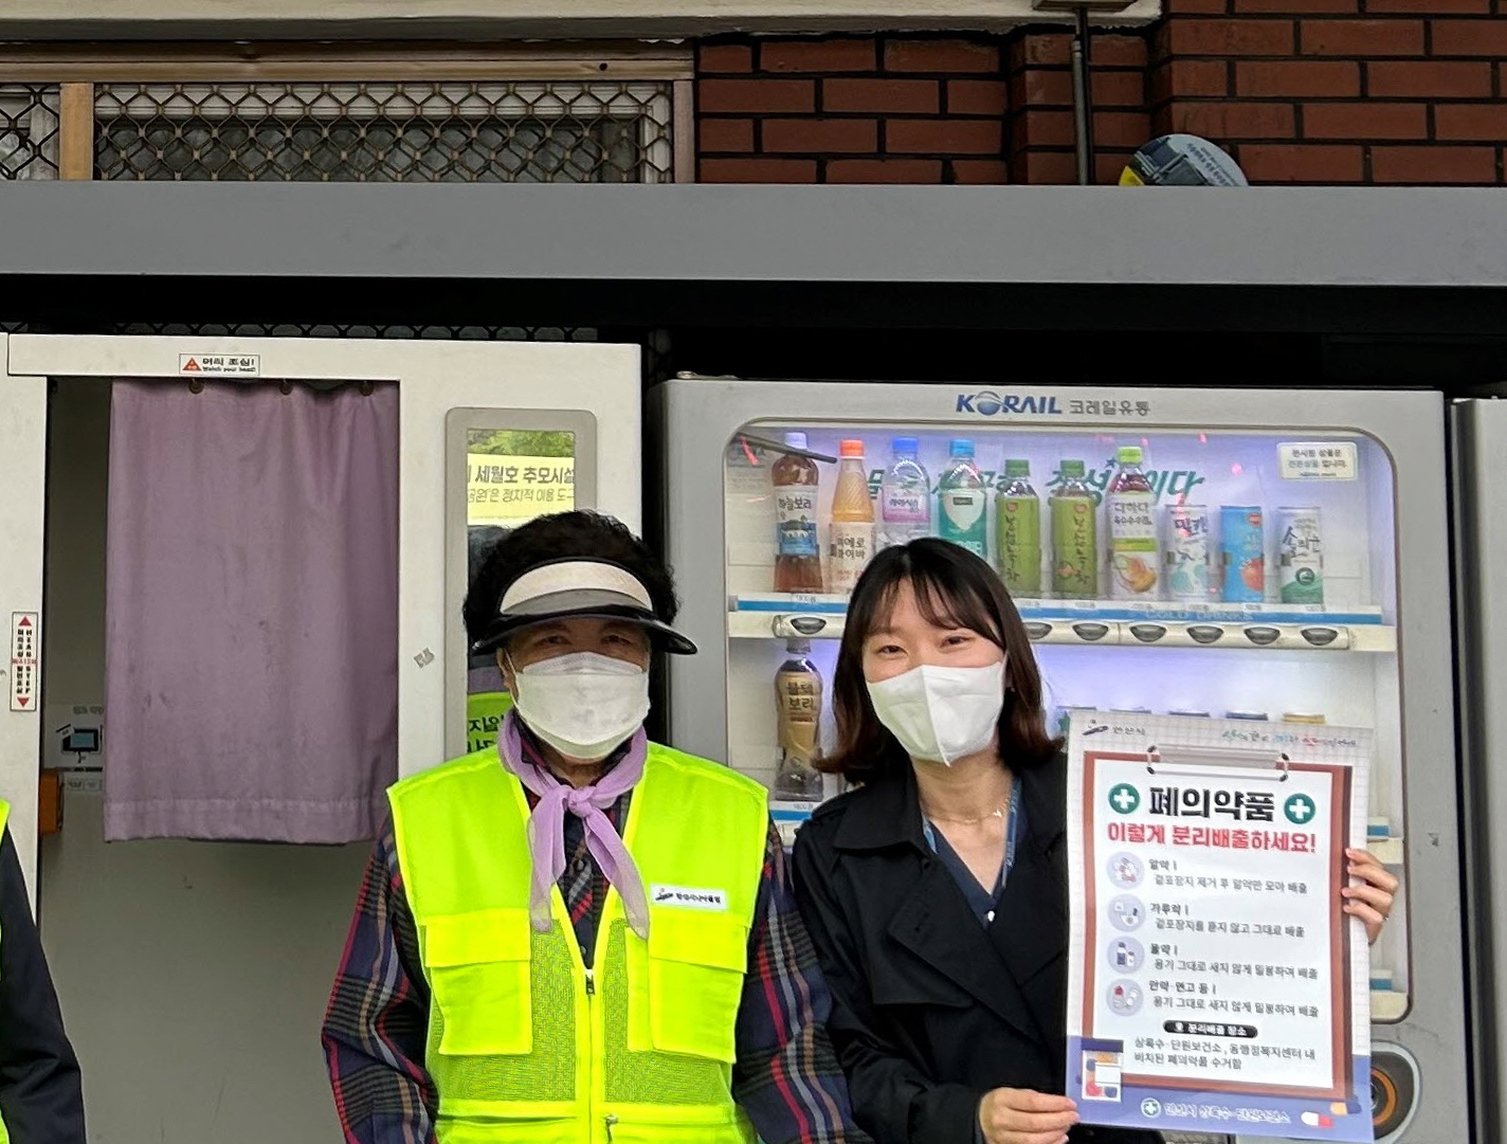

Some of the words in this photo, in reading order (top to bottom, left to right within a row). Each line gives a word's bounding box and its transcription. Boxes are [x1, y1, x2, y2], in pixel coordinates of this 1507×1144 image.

[955, 390, 1063, 416] KORAIL
[1069, 400, 1151, 416] 코레일유통
[475, 465, 519, 484] 세월호
[789, 697, 814, 711] 보리
[1149, 786, 1276, 823] 폐의약품
[1107, 822, 1166, 845] 이렇게
[1172, 823, 1317, 854] 분리배출하세요!
[1197, 875, 1217, 888] 제거
